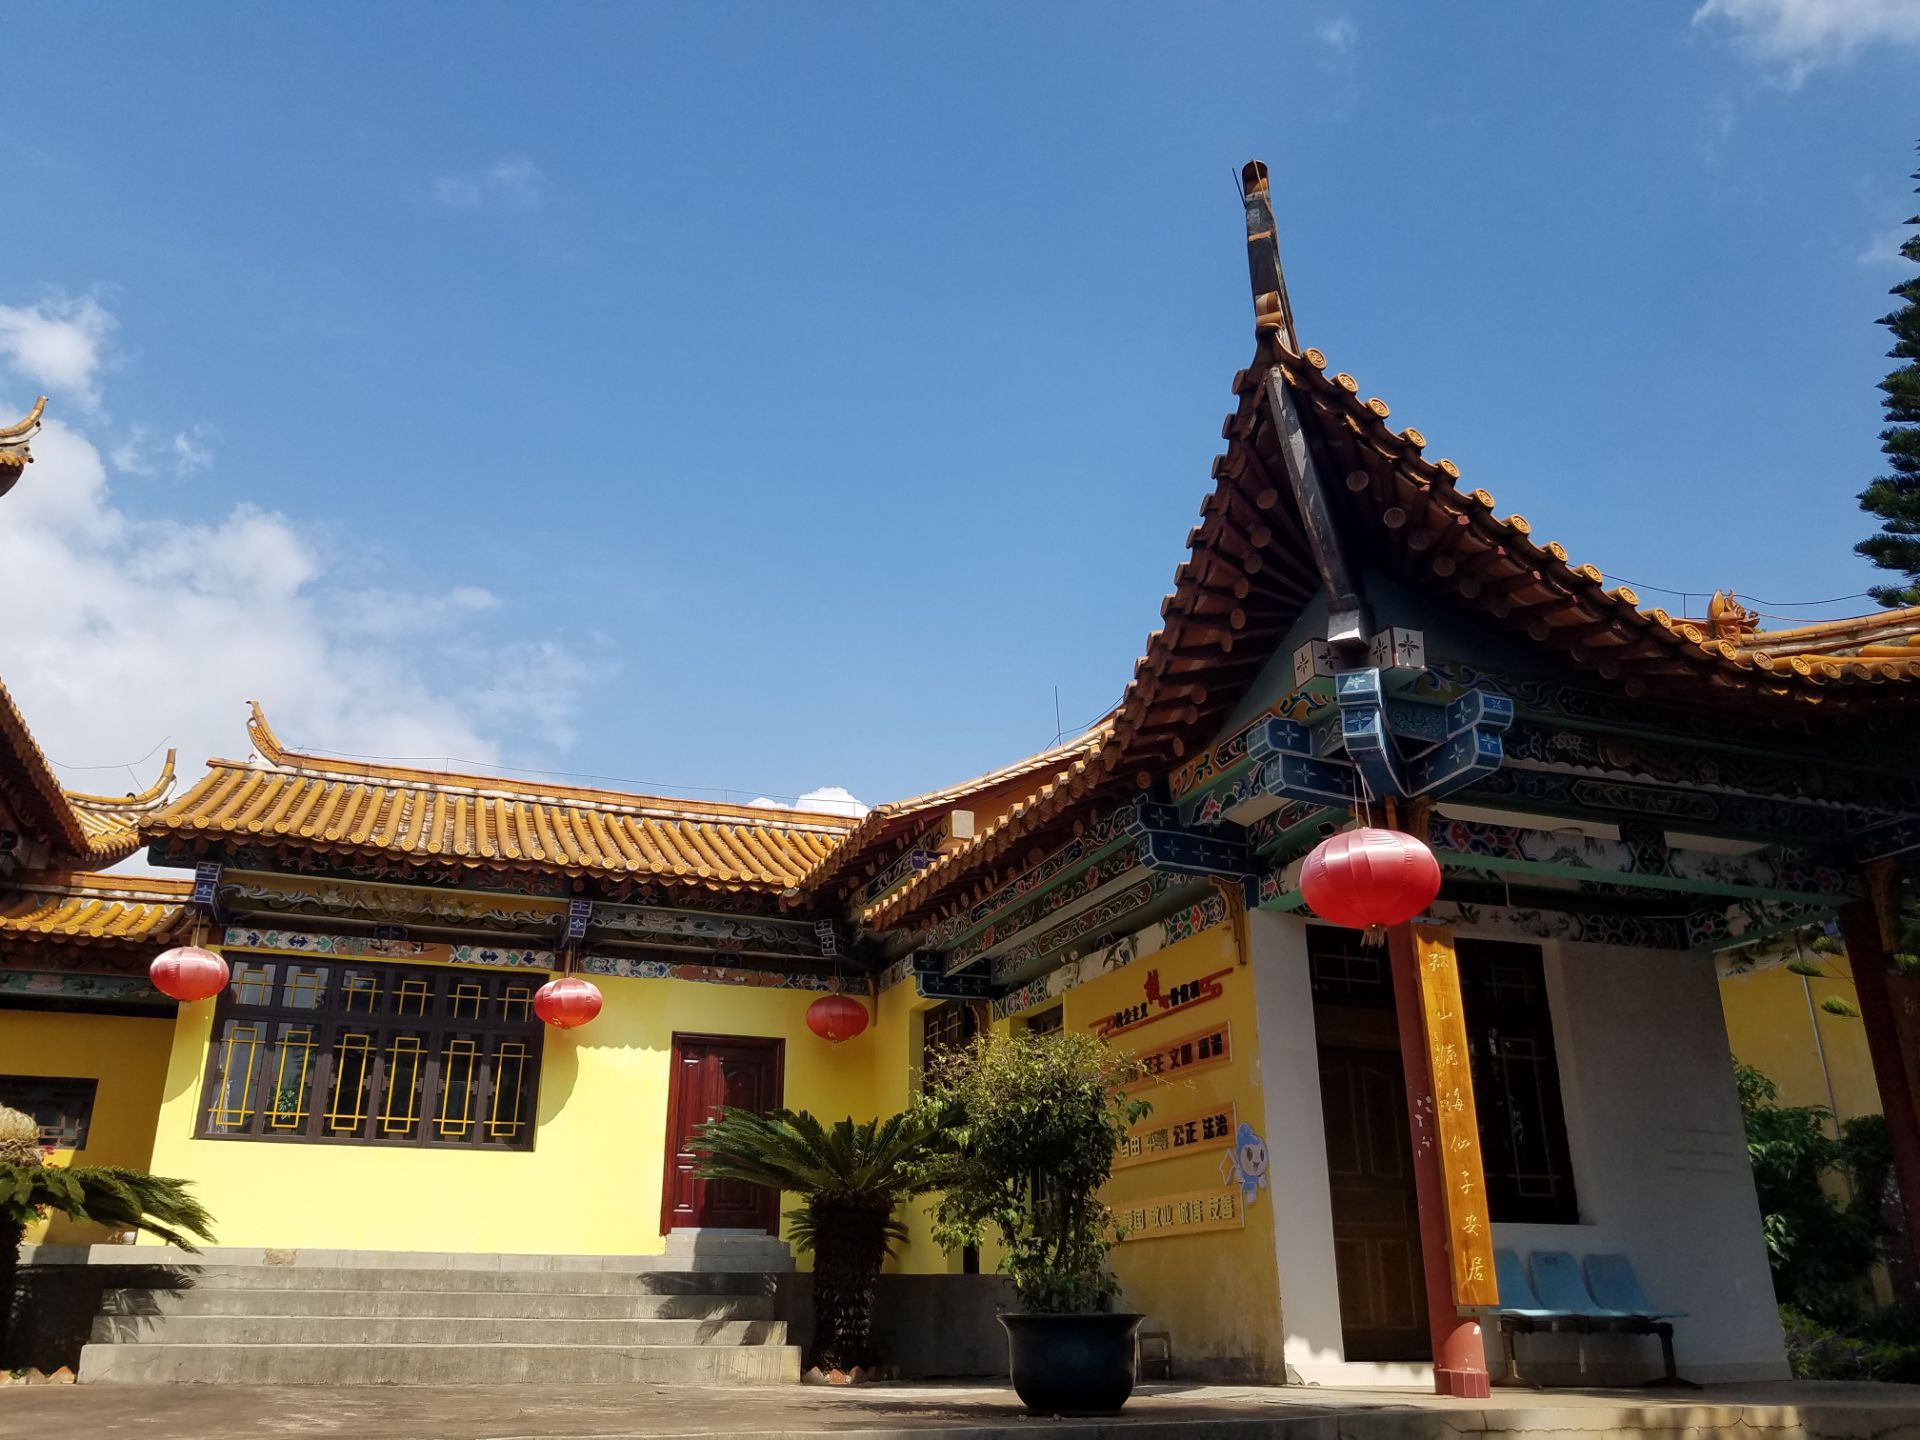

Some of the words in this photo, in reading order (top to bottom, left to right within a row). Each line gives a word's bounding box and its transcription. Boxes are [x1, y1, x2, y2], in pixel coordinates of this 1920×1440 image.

[1169, 1043, 1193, 1069] 文明
[1145, 1128, 1169, 1152] 平等
[1173, 1121, 1198, 1147] 公正
[1202, 1113, 1229, 1140] 法治
[1178, 1199, 1204, 1225] 诚信
